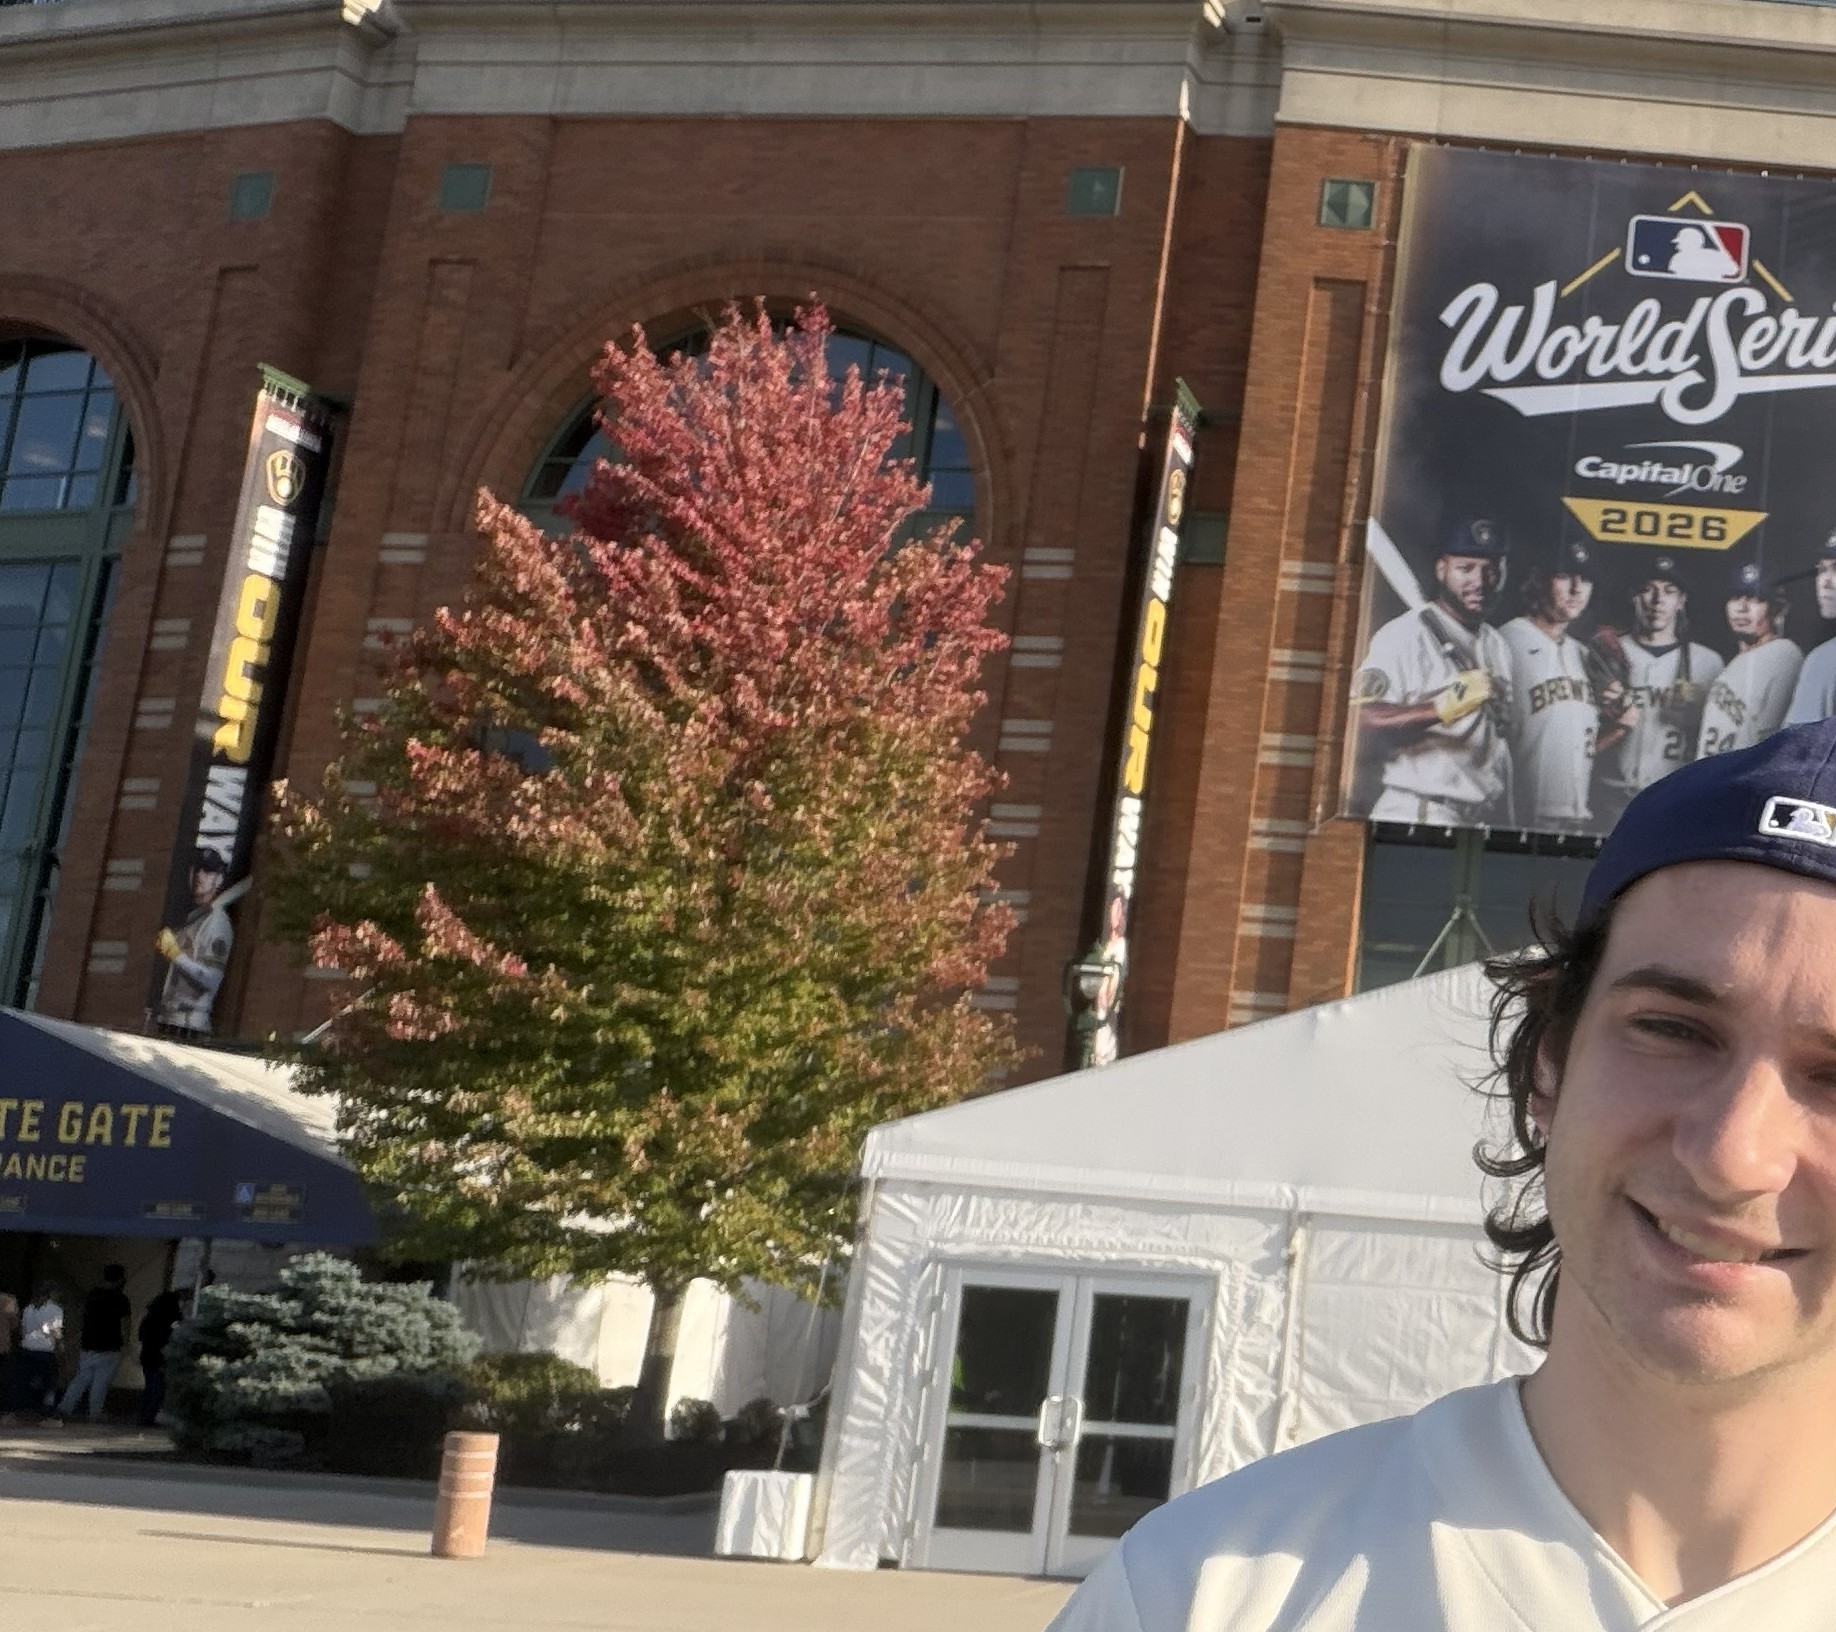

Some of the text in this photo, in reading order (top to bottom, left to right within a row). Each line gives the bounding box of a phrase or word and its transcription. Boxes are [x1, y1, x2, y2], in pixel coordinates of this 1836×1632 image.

[1600, 508, 1727, 541] 2026
[212, 573, 282, 764] OUR
[1124, 597, 1167, 795] OUR
[195, 765, 248, 864] WAY
[57, 1101, 176, 1148] GATE
[0, 1153, 87, 1183] ANCE
